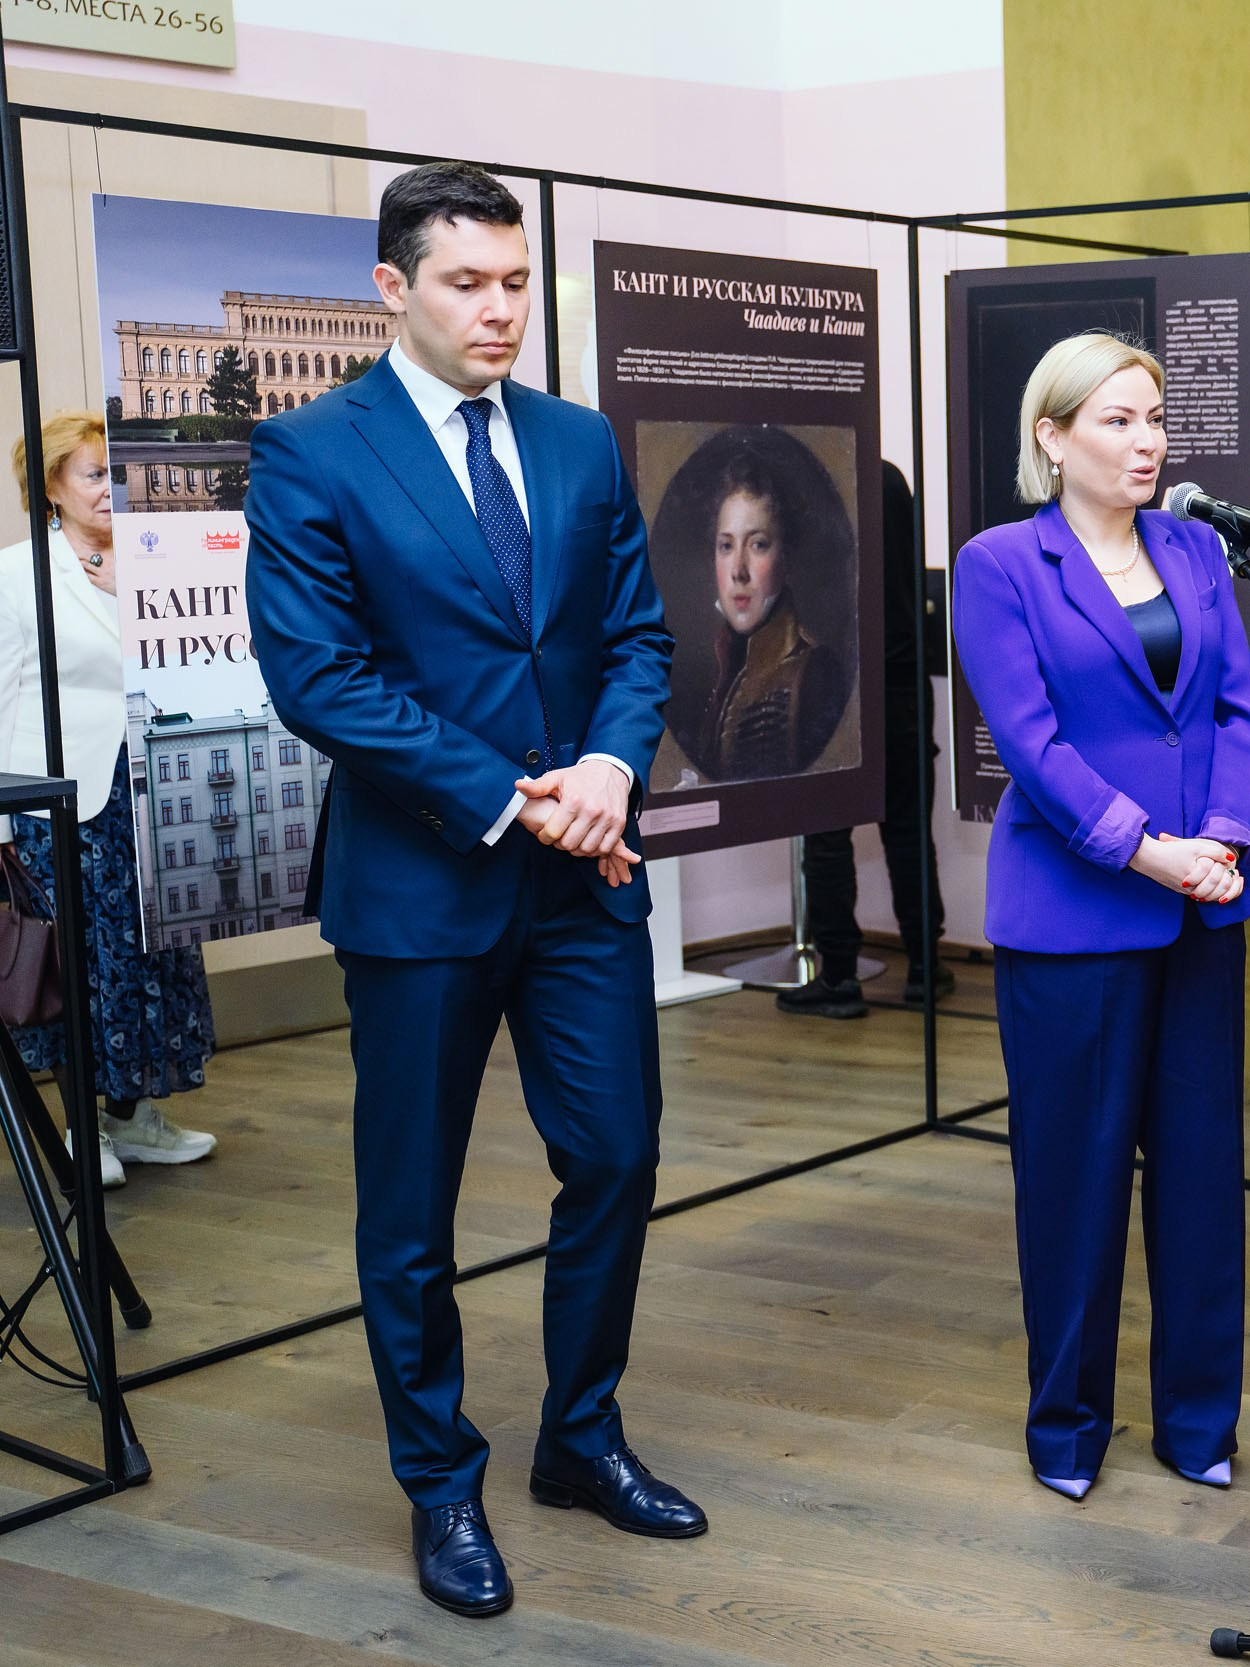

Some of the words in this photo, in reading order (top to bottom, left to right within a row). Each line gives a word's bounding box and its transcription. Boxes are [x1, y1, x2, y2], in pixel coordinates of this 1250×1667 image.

[65, 0, 147, 25] МЕСТА
[154, 7, 224, 35] 26-56
[612, 269, 669, 296] КАНТ
[672, 275, 689, 298] И
[692, 277, 777, 305] РУССКАЯ
[780, 285, 865, 313] КУЛЬТУРА
[743, 308, 806, 333] Чаадаев
[809, 317, 820, 333] и
[822, 314, 866, 337] Кант
[134, 585, 238, 620] КАНТ
[138, 638, 168, 669] И
[973, 804, 996, 823] КА
